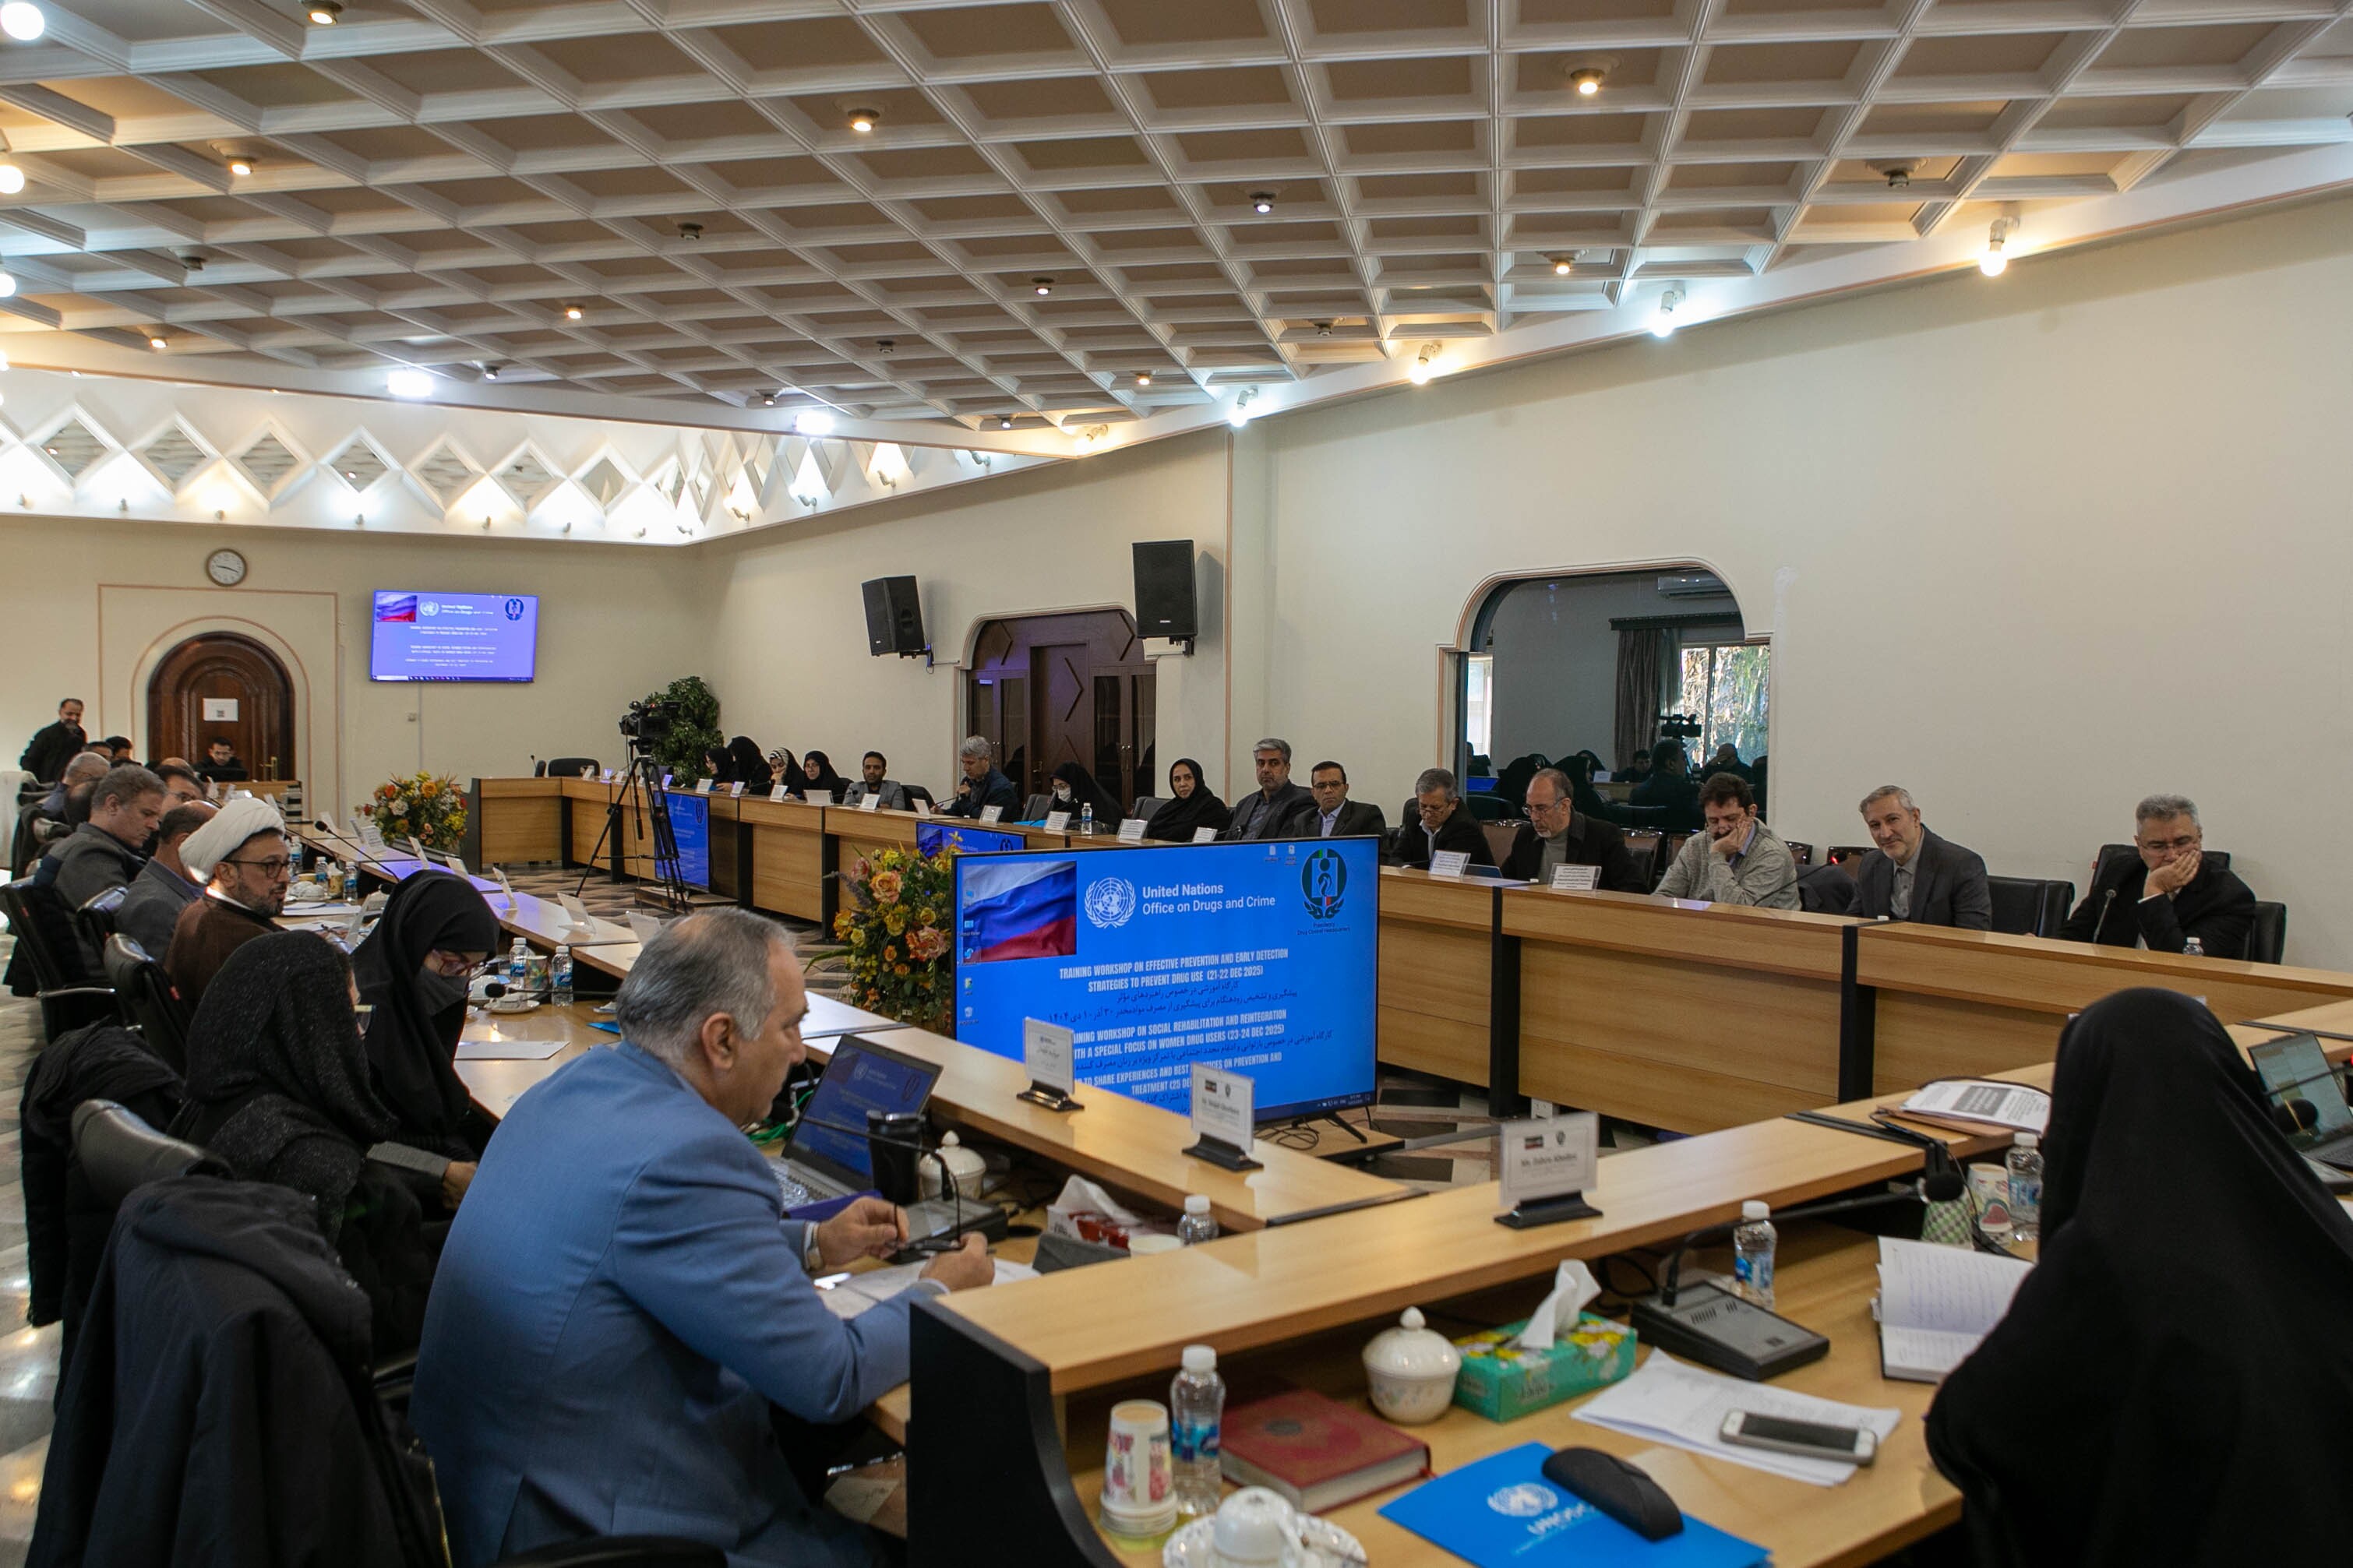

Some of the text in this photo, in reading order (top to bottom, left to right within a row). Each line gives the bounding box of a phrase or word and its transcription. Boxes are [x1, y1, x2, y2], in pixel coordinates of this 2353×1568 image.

[1142, 883, 1223, 898] United Nations
[1142, 895, 1275, 915] Office on Drugs and Crime
[1060, 948, 1289, 980] TRAINING WORKSHOP ON EFFECTIVE PREVENTION AND EARLY DETECTION
[1088, 966, 1263, 992] STRATEGIES TO PREVENT DRUG USE (21-22 DEC 2025)
[1097, 1027, 1135, 1041] WORKSHOP
[1137, 1025, 1147, 1037] ON
[1148, 1023, 1171, 1035] SOCIAL
[1173, 1015, 1224, 1032] REHABILITATION
[1226, 1013, 1239, 1026] AND
[1240, 1009, 1286, 1024] REINTEGRATION
[1074, 1048, 1086, 1060] ITH
[1088, 1047, 1092, 1059] A
[1095, 1044, 1122, 1057] SPECIAL
[1124, 1040, 1146, 1053] FOCUS
[1148, 1038, 1157, 1051] ON
[1159, 1035, 1185, 1049] WOMEN
[1187, 1033, 1205, 1046] DRUG
[1206, 1030, 1226, 1043] USERS
[1228, 1027, 1250, 1041] (23-24
[1252, 1026, 1263, 1038] DEC
[1265, 1024, 1285, 1036] 2025)
[1094, 1073, 1115, 1087] SHARE
[1117, 1069, 1158, 1084] EXPERIENCES
[1159, 1066, 1173, 1079] AND
[1173, 1063, 1188, 1076] BEST
[1224, 1058, 1233, 1069] ON
[1234, 1054, 1268, 1067] PREVENTION
[1270, 1052, 1282, 1063] AND
[1131, 1081, 1168, 1095] TREATMENT
